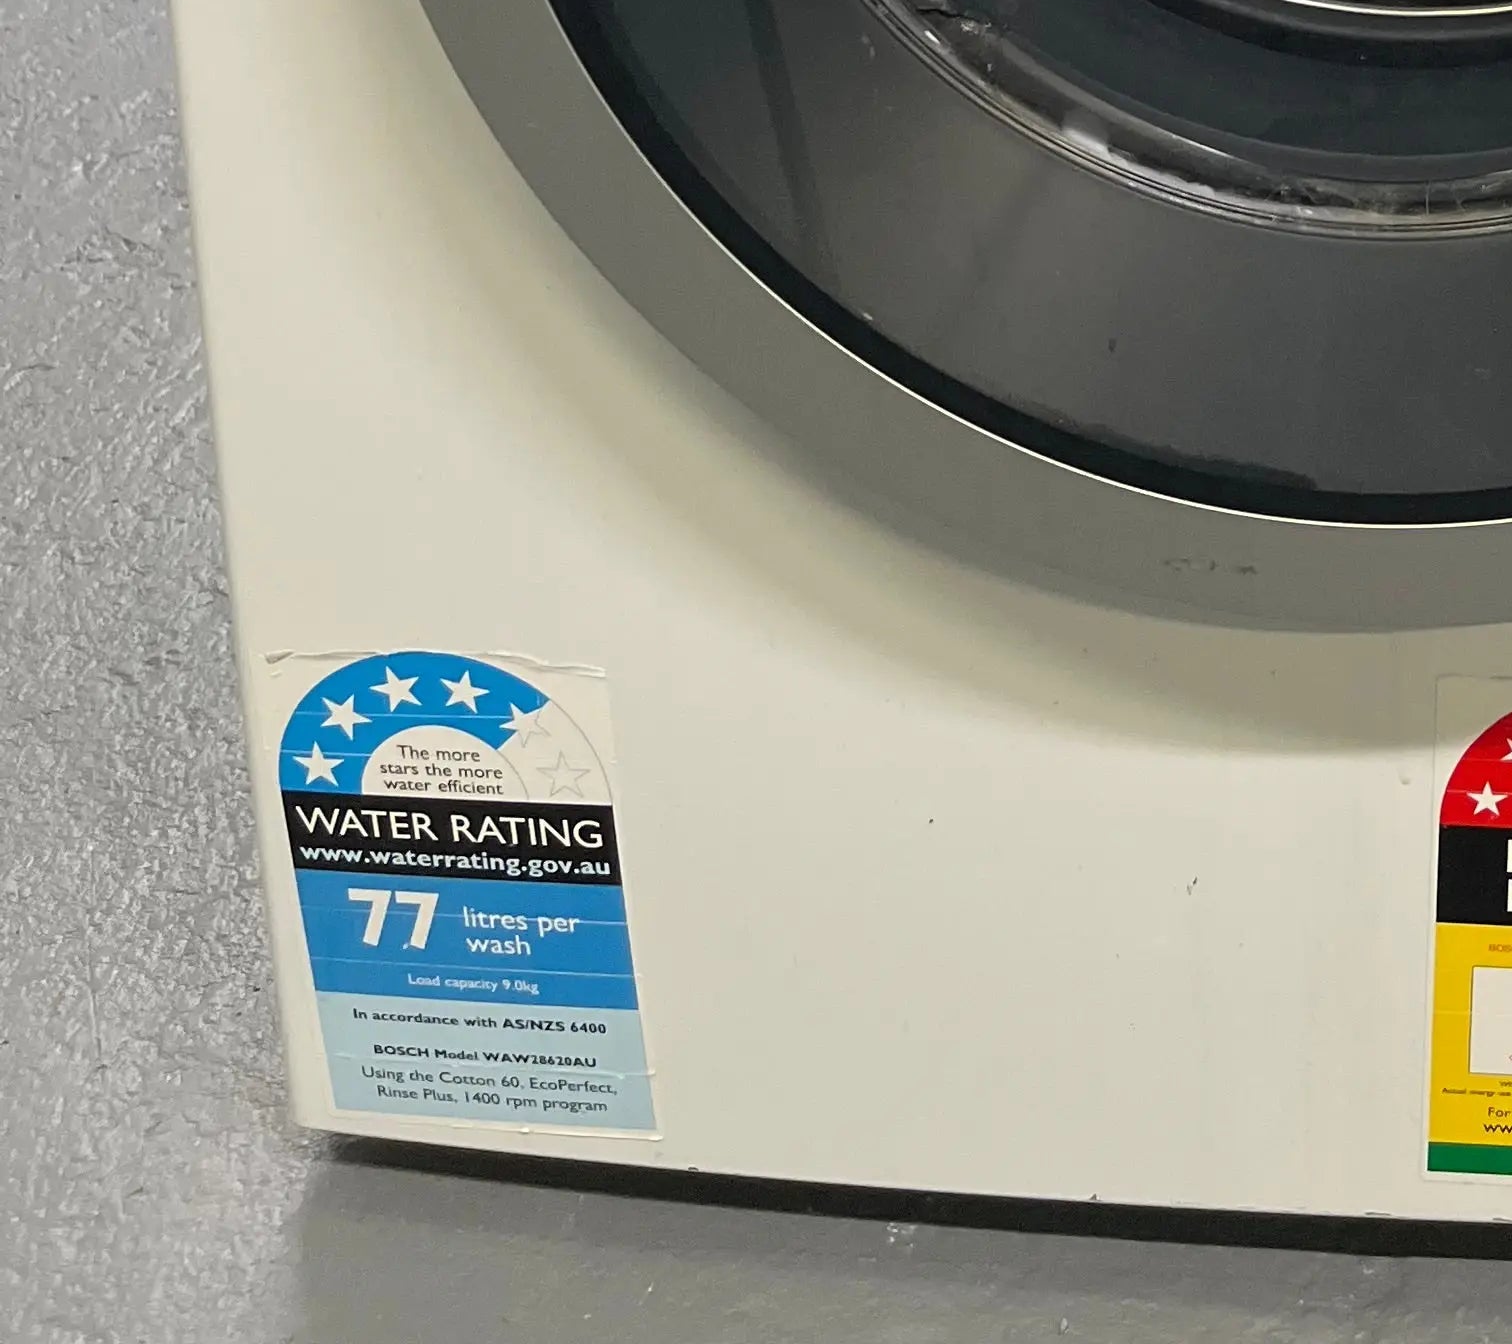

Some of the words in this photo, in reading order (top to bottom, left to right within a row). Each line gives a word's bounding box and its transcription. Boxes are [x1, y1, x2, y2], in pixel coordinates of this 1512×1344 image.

[396, 744, 431, 761] The
[435, 749, 481, 763] more
[379, 762, 419, 776] stars
[424, 763, 452, 777] the
[458, 766, 504, 780] more
[383, 779, 433, 792] water
[437, 779, 505, 796] efficient
[295, 805, 439, 842] WATER
[451, 814, 605, 849] RATING
[299, 843, 612, 878] www.waterrating.gov.au
[347, 887, 440, 951] 77
[462, 905, 528, 932] litres
[537, 913, 581, 937] per
[466, 934, 532, 957] wash
[406, 973, 441, 988] Load
[444, 976, 499, 993] capacity
[352, 1008, 368, 1021] In
[371, 1011, 460, 1028] accordance
[463, 1015, 498, 1030] with
[501, 1017, 566, 1034] AS/NZS
[569, 1020, 607, 1035] 6400
[372, 1043, 430, 1059] BOSCH
[434, 1046, 480, 1062] Model
[482, 1050, 598, 1069] WAW28620AU
[361, 1065, 406, 1085] Using
[408, 1068, 435, 1084] the
[438, 1070, 497, 1088] Cotton
[528, 1077, 618, 1096] EcoPerfect,
[376, 1084, 419, 1101] Rinse
[422, 1087, 459, 1105] Plus,
[463, 1090, 502, 1106] 1400
[505, 1095, 539, 1110] rpm
[542, 1097, 609, 1114] program
[1487, 1107, 1512, 1119] For
